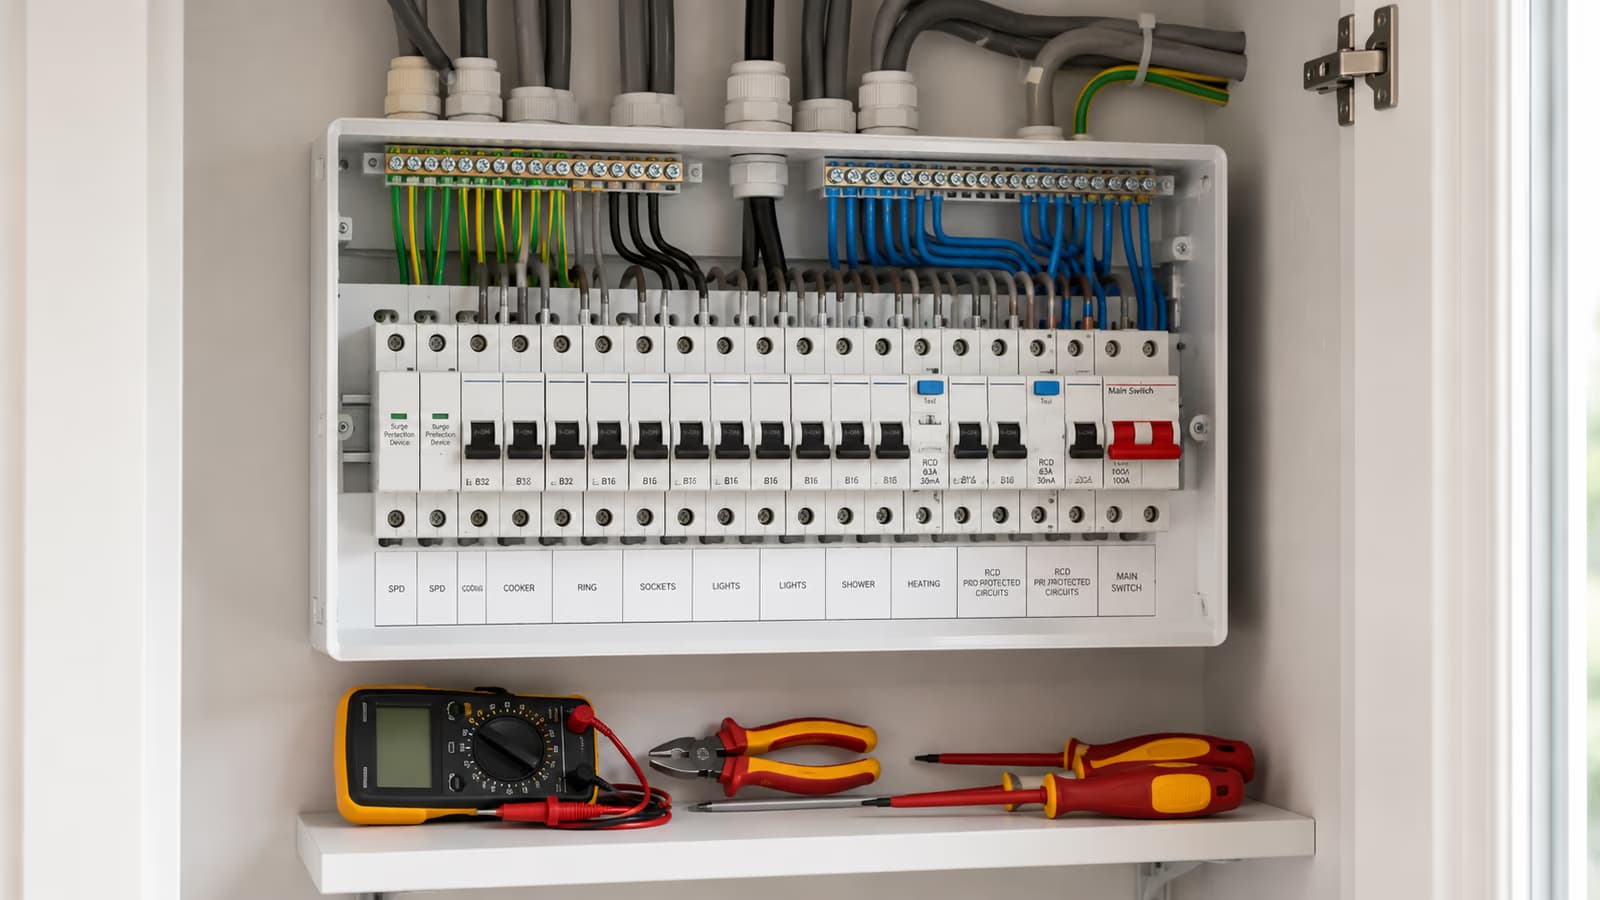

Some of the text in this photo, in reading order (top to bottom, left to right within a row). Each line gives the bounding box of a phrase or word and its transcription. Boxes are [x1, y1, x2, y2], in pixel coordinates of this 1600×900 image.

[1107, 386, 1128, 394] Main
[1038, 458, 1055, 467] RCD
[474, 477, 490, 486] B32
[558, 477, 574, 486] B32
[601, 476, 617, 486] B16
[642, 476, 658, 486] B16
[723, 476, 739, 485] B16
[763, 476, 779, 485] B16
[804, 476, 819, 485] B16
[844, 475, 859, 485] B16
[984, 568, 1001, 577] RCD
[1054, 567, 1071, 577] RCD
[1116, 572, 1138, 581] MAIN
[503, 583, 536, 593] COOKER
[577, 583, 598, 592] RING
[639, 582, 677, 591] SOCKETS
[712, 581, 741, 591] LIGHTS
[779, 580, 807, 590] LIGHTS
[841, 580, 876, 589] SHOWER
[907, 579, 941, 588] HEATING
[1111, 583, 1143, 593] SWITCH
[388, 584, 406, 593] SPD
[428, 584, 446, 593] SPD
[975, 587, 1009, 597] CIRCUITS
[1045, 587, 1080, 597] CIRCUITS
